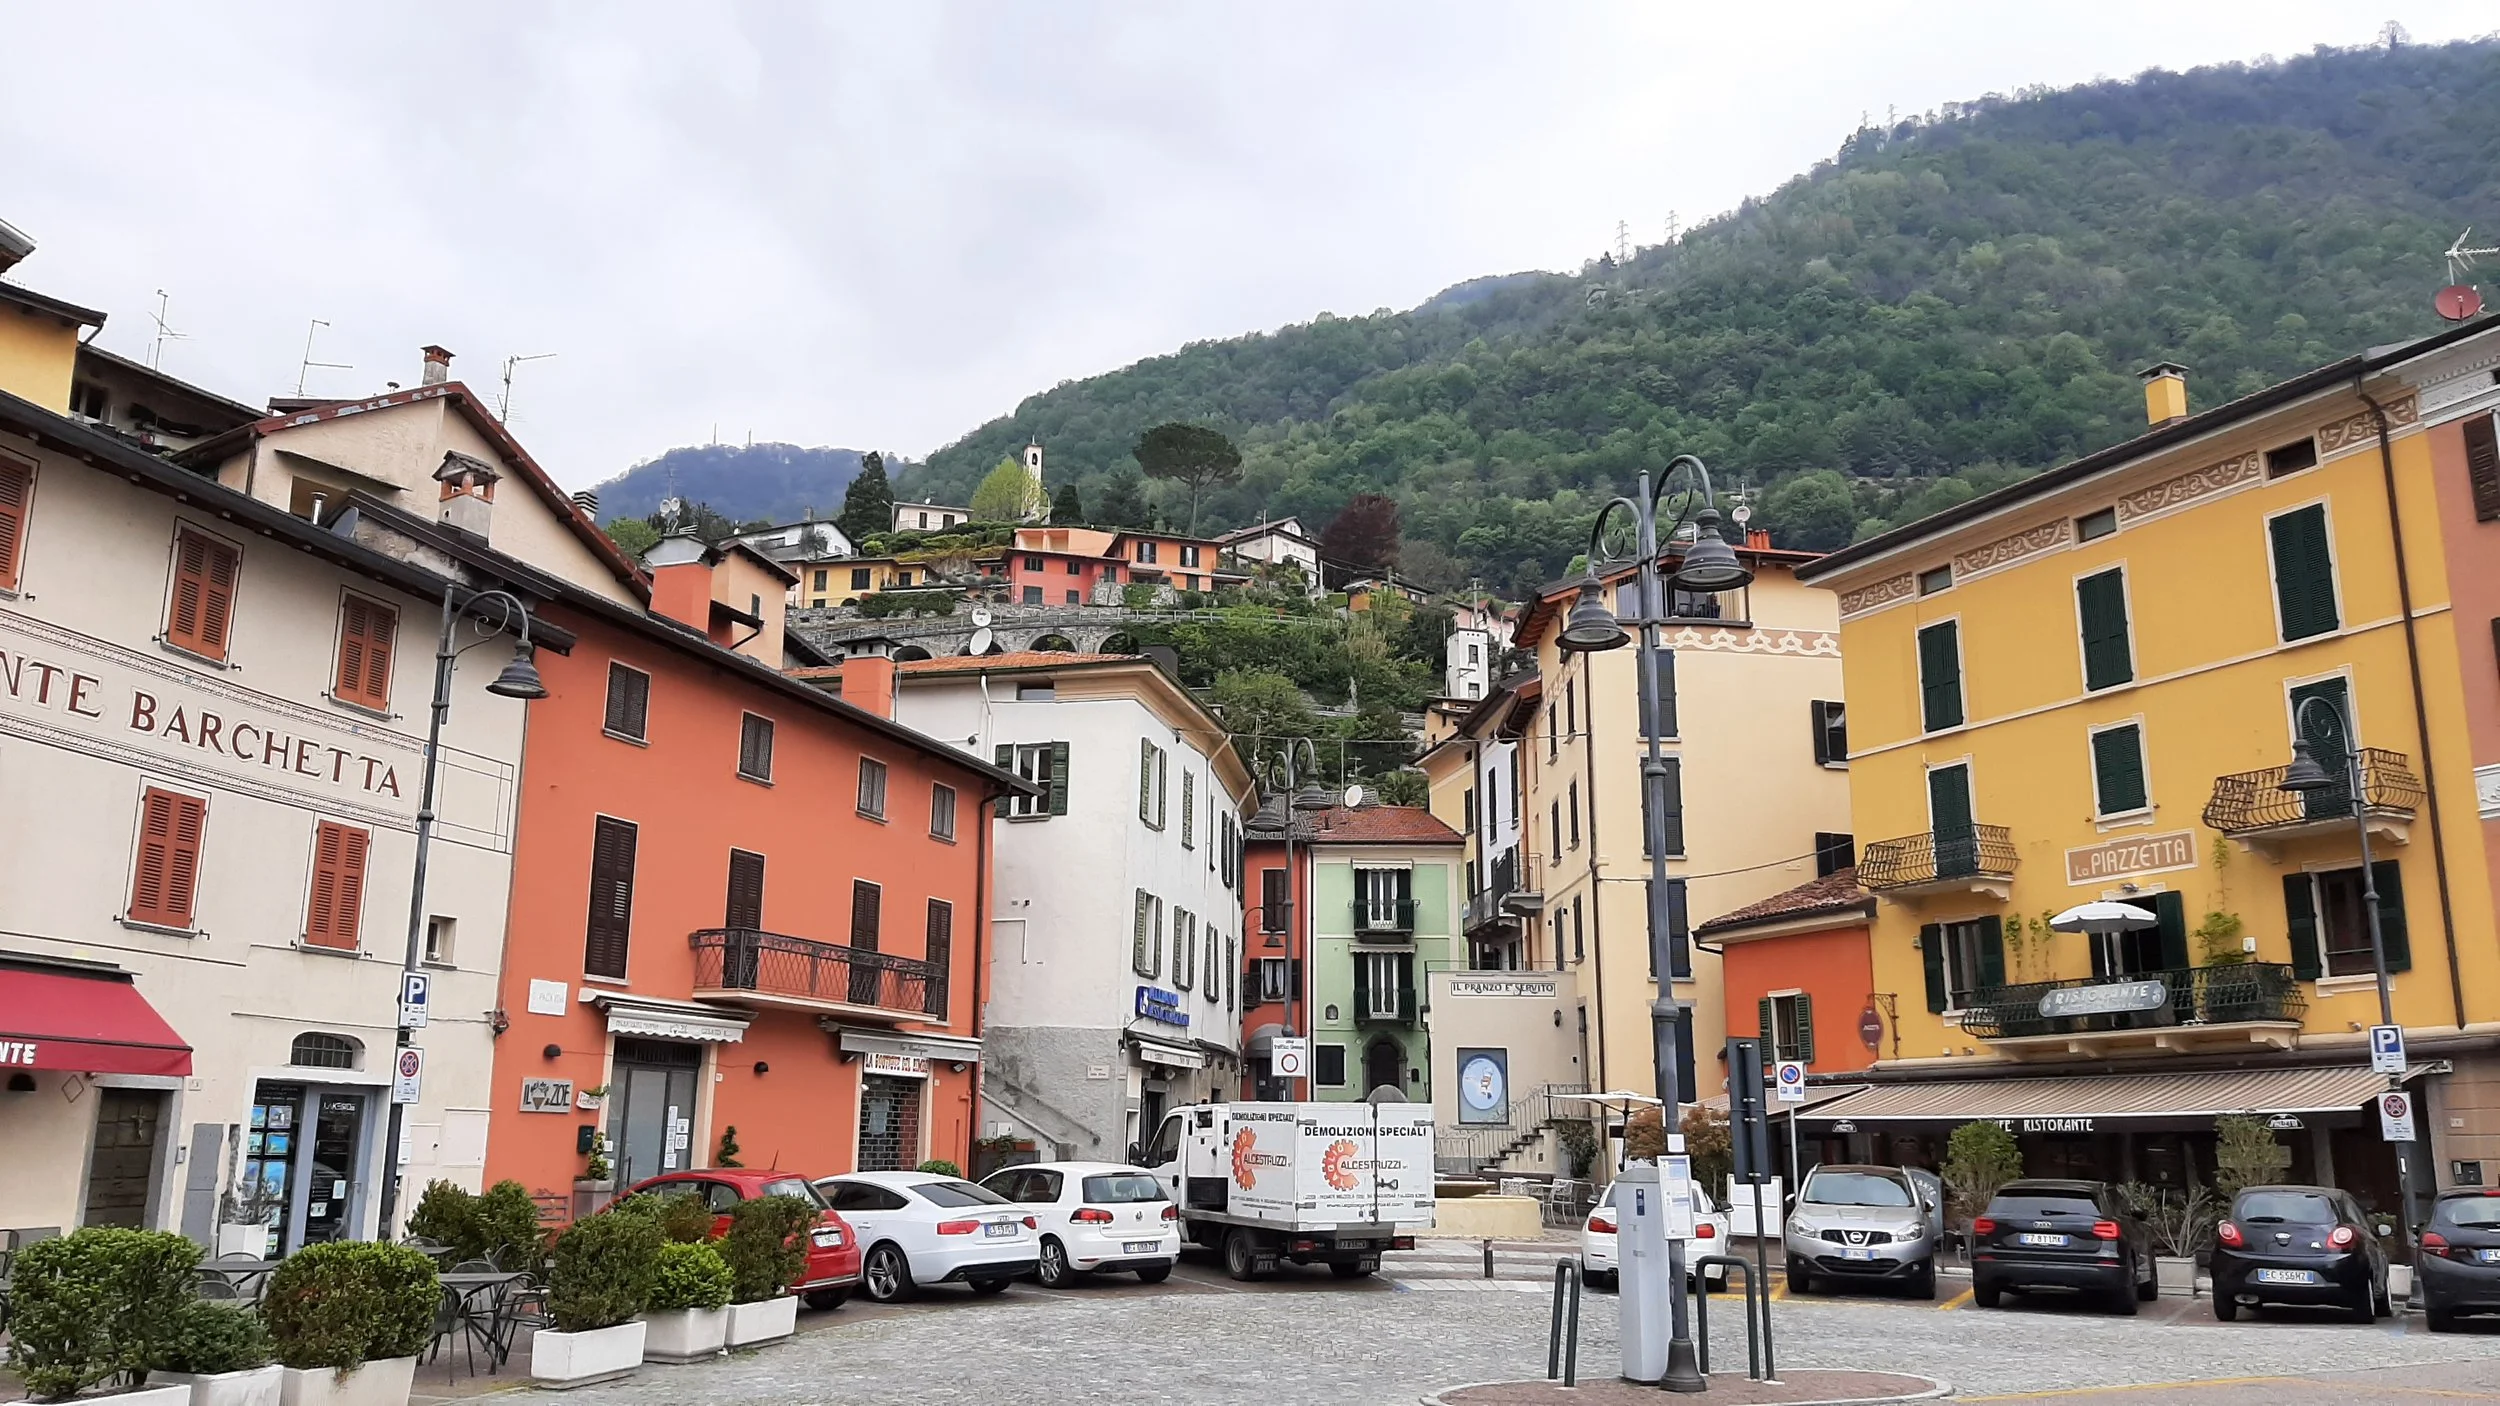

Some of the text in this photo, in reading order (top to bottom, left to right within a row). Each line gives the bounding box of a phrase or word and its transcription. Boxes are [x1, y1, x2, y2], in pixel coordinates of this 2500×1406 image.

[130, 690, 402, 798] BARCHETTA
[2090, 838, 2187, 875] PIAZZETTA
[407, 976, 425, 1003] P
[1452, 983, 1461, 992] IL
[1464, 983, 1501, 994] PRANZO
[1513, 983, 1554, 996] SERVITO
[2377, 1029, 2397, 1052] P
[0, 1041, 37, 1065] NTE
[1304, 1127, 1427, 1137] DEMOLIZIONI SPECIALI
[2023, 1118, 2095, 1132] RISTORANTE
